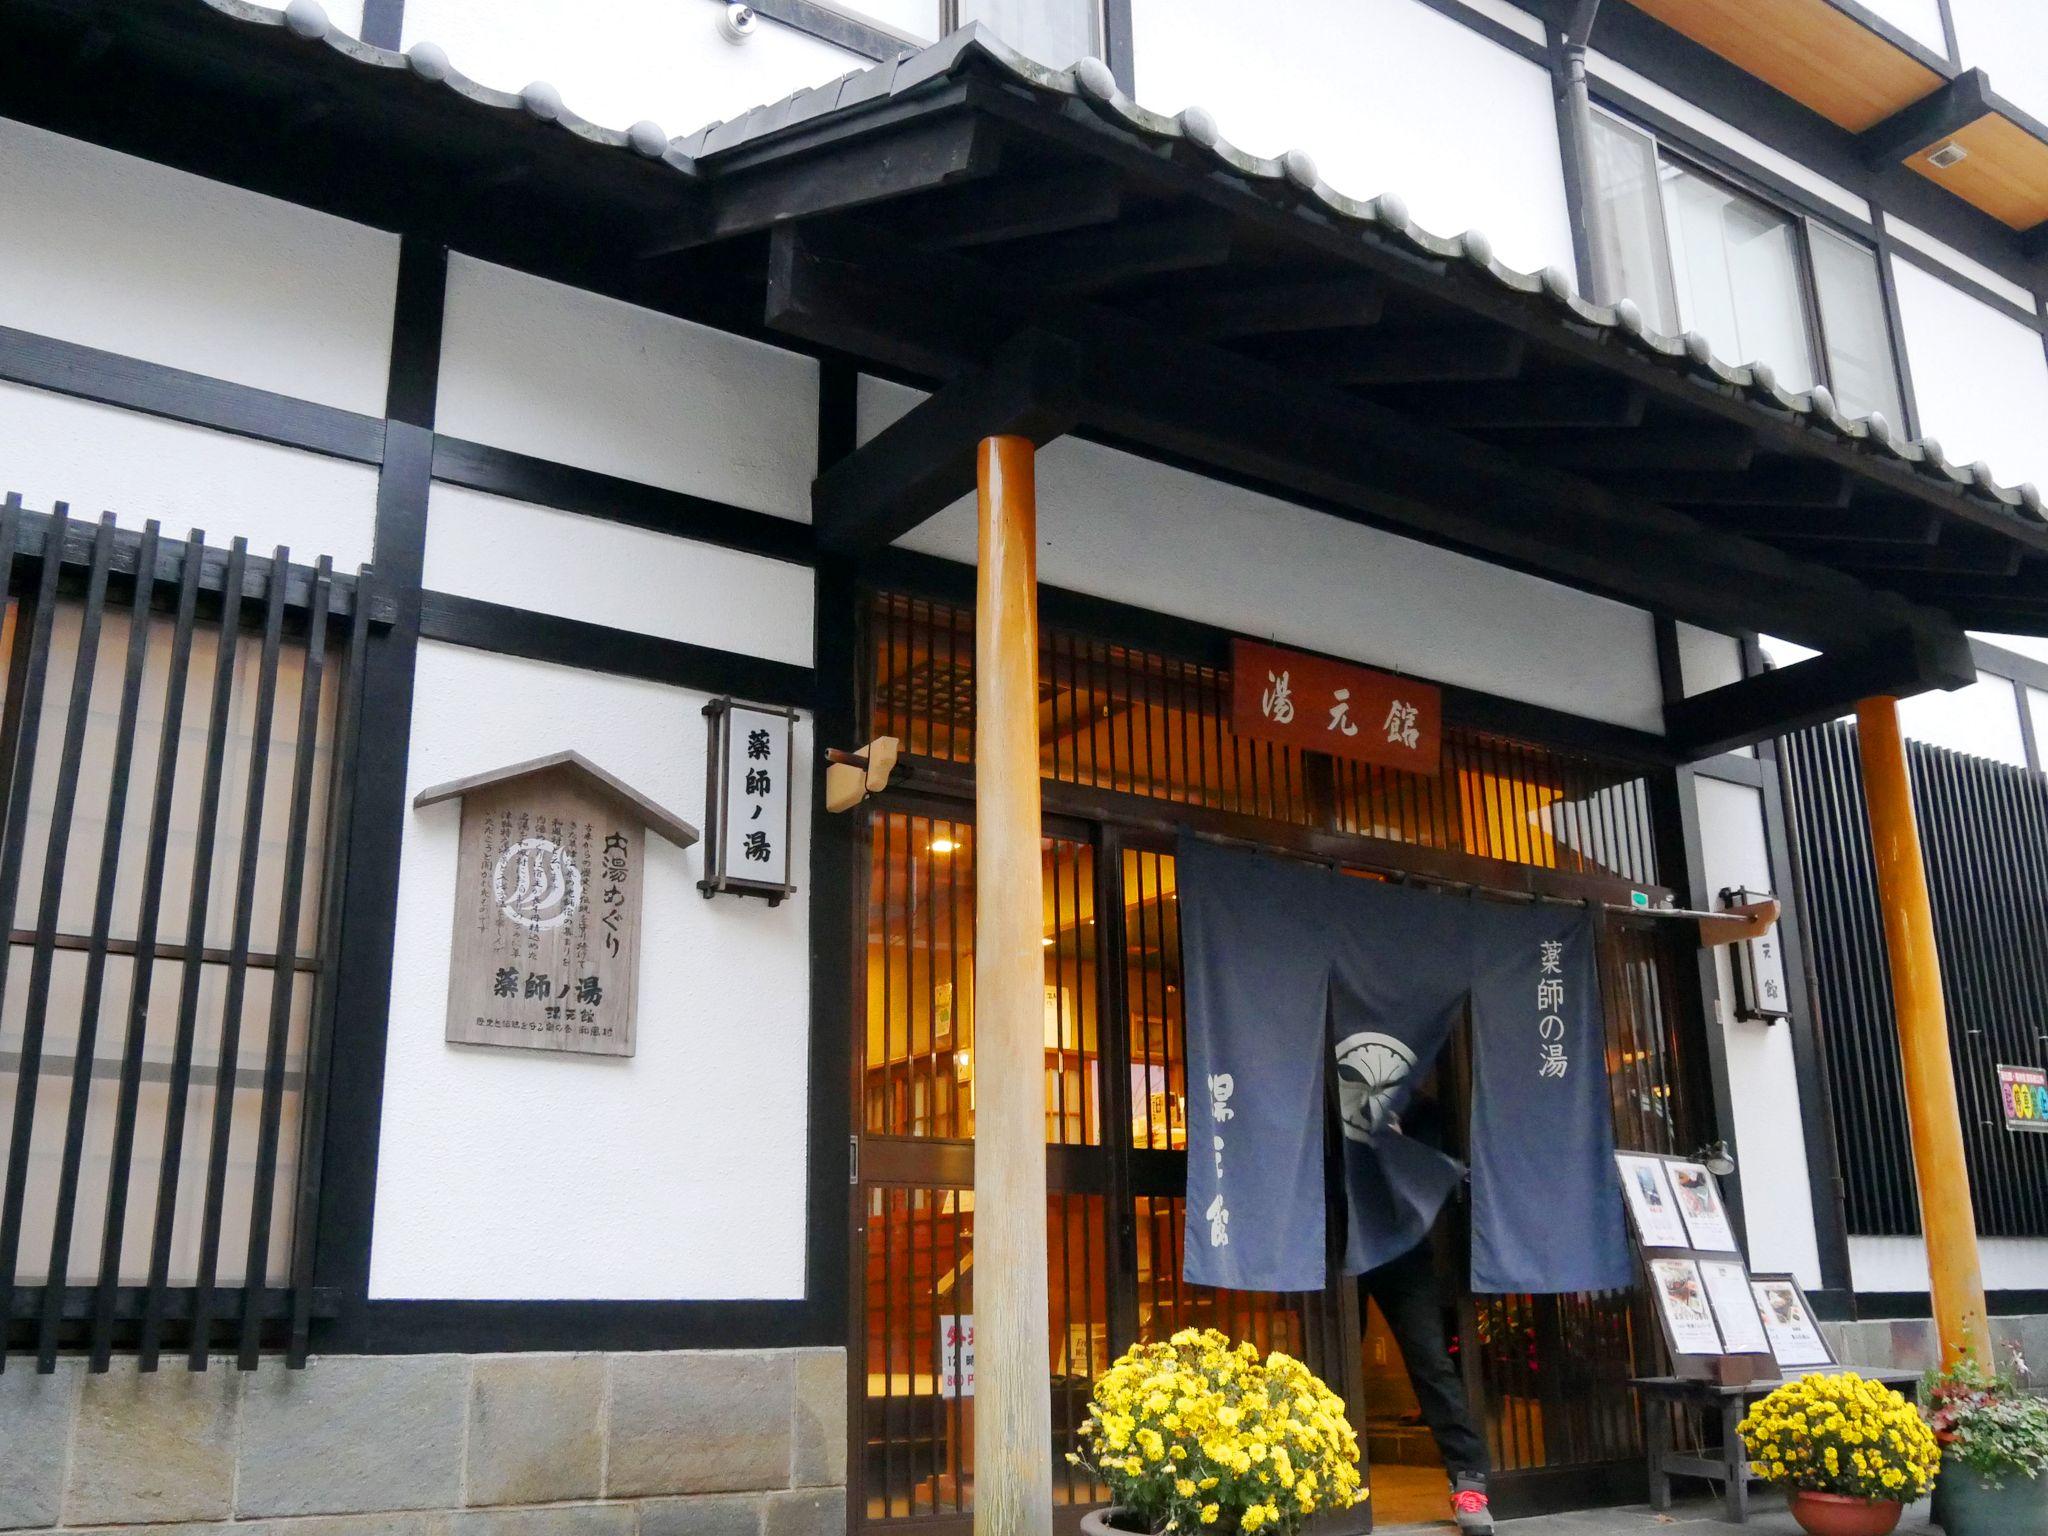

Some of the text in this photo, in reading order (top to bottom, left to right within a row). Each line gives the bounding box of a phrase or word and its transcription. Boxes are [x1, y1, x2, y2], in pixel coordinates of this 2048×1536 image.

[1262, 669, 1420, 750] 湯元館
[742, 729, 772, 863] 薬師ノ湯
[602, 831, 629, 959] 内湯めぐり
[494, 966, 603, 1007] 薬師ノ湯
[1538, 940, 1567, 1078] 薬師の湯
